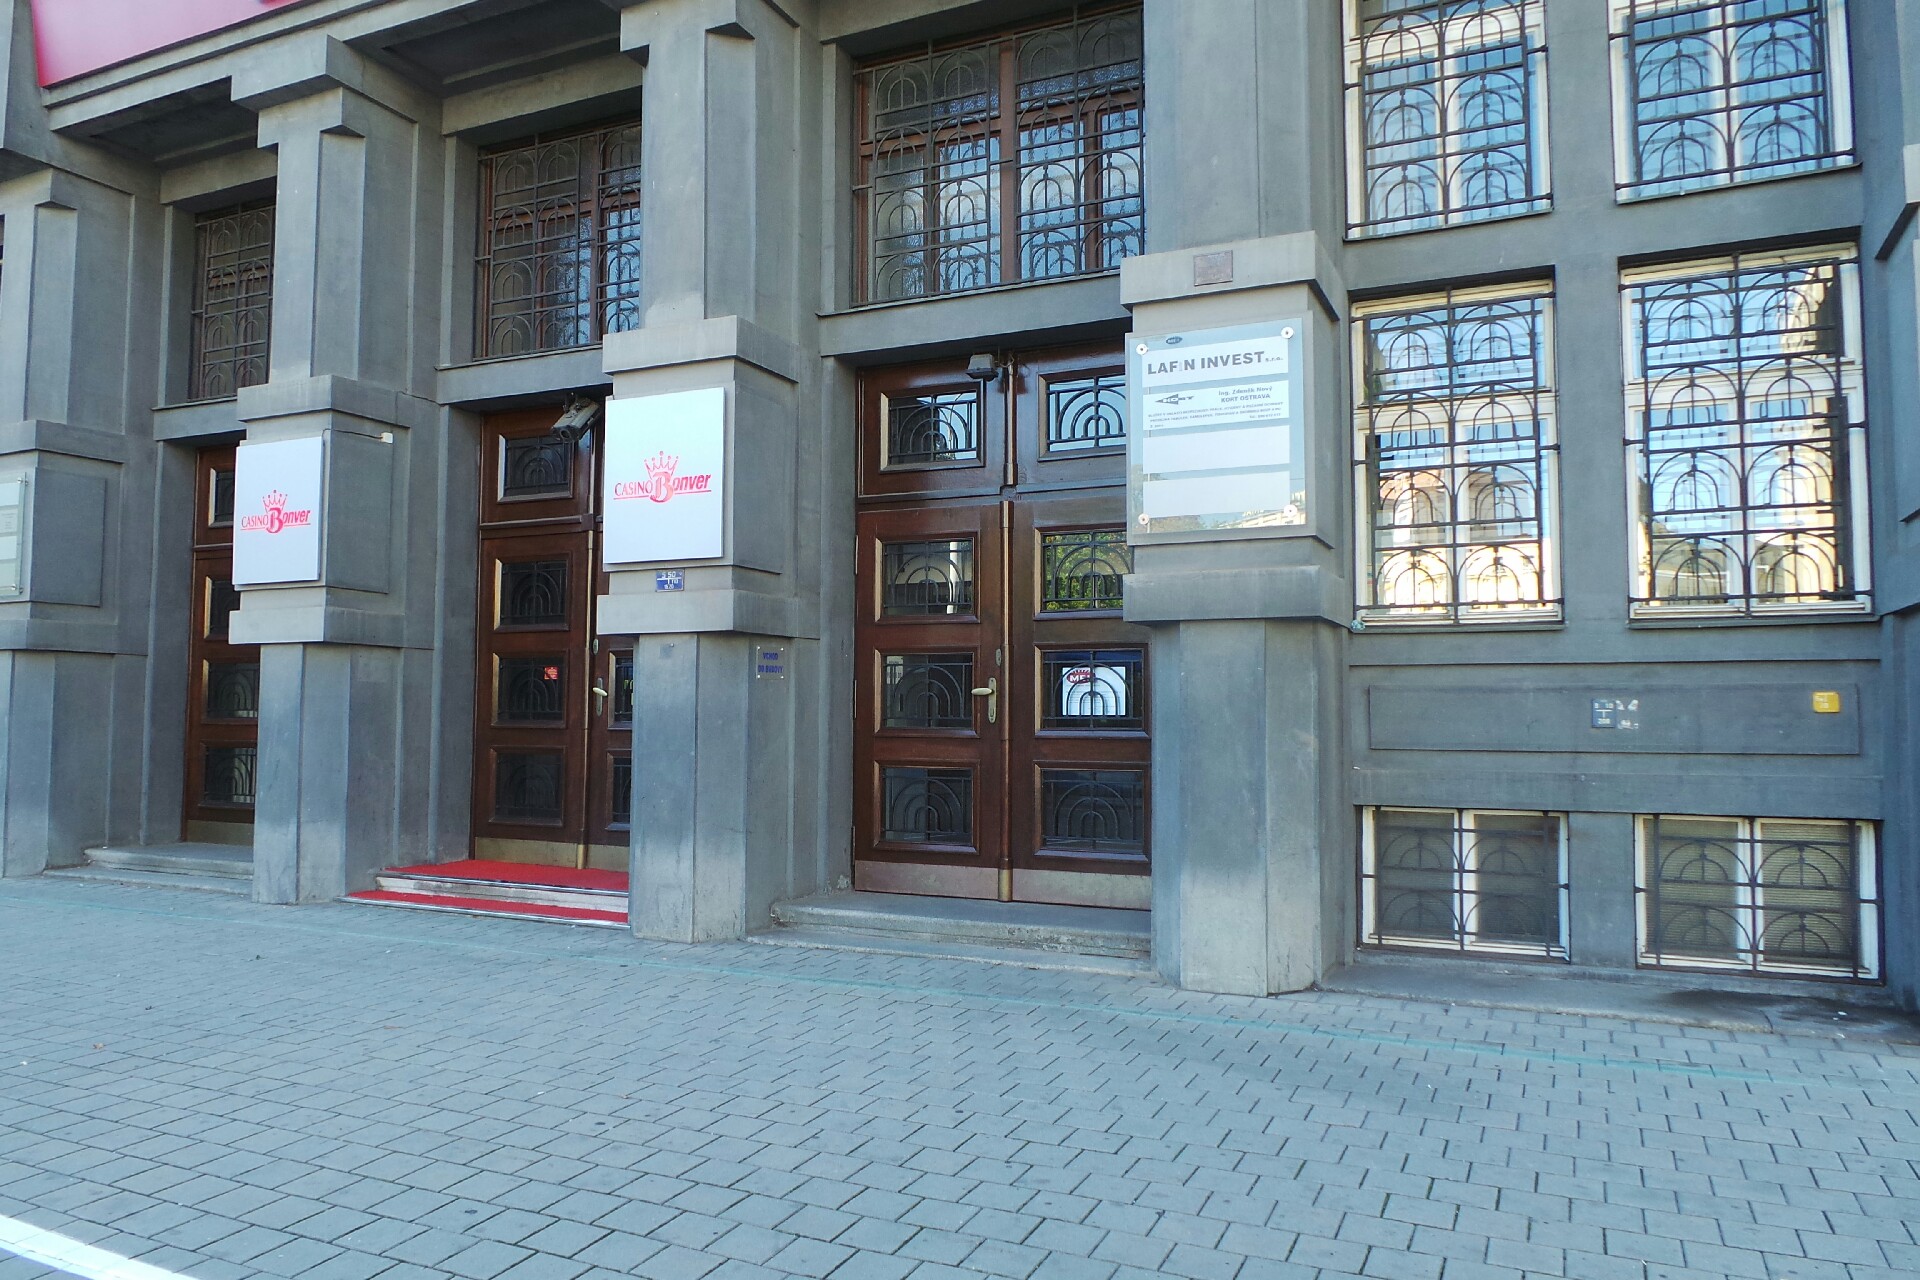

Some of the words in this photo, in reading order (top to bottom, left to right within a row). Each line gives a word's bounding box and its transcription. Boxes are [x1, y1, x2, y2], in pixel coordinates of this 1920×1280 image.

[1200, 350, 1265, 369] INVEST
[1239, 393, 1271, 401] OSTRAVA
[614, 479, 654, 497] CASINO
[650, 471, 712, 503] Bonver
[241, 514, 269, 528] CASINO
[266, 507, 311, 534] Bonver
